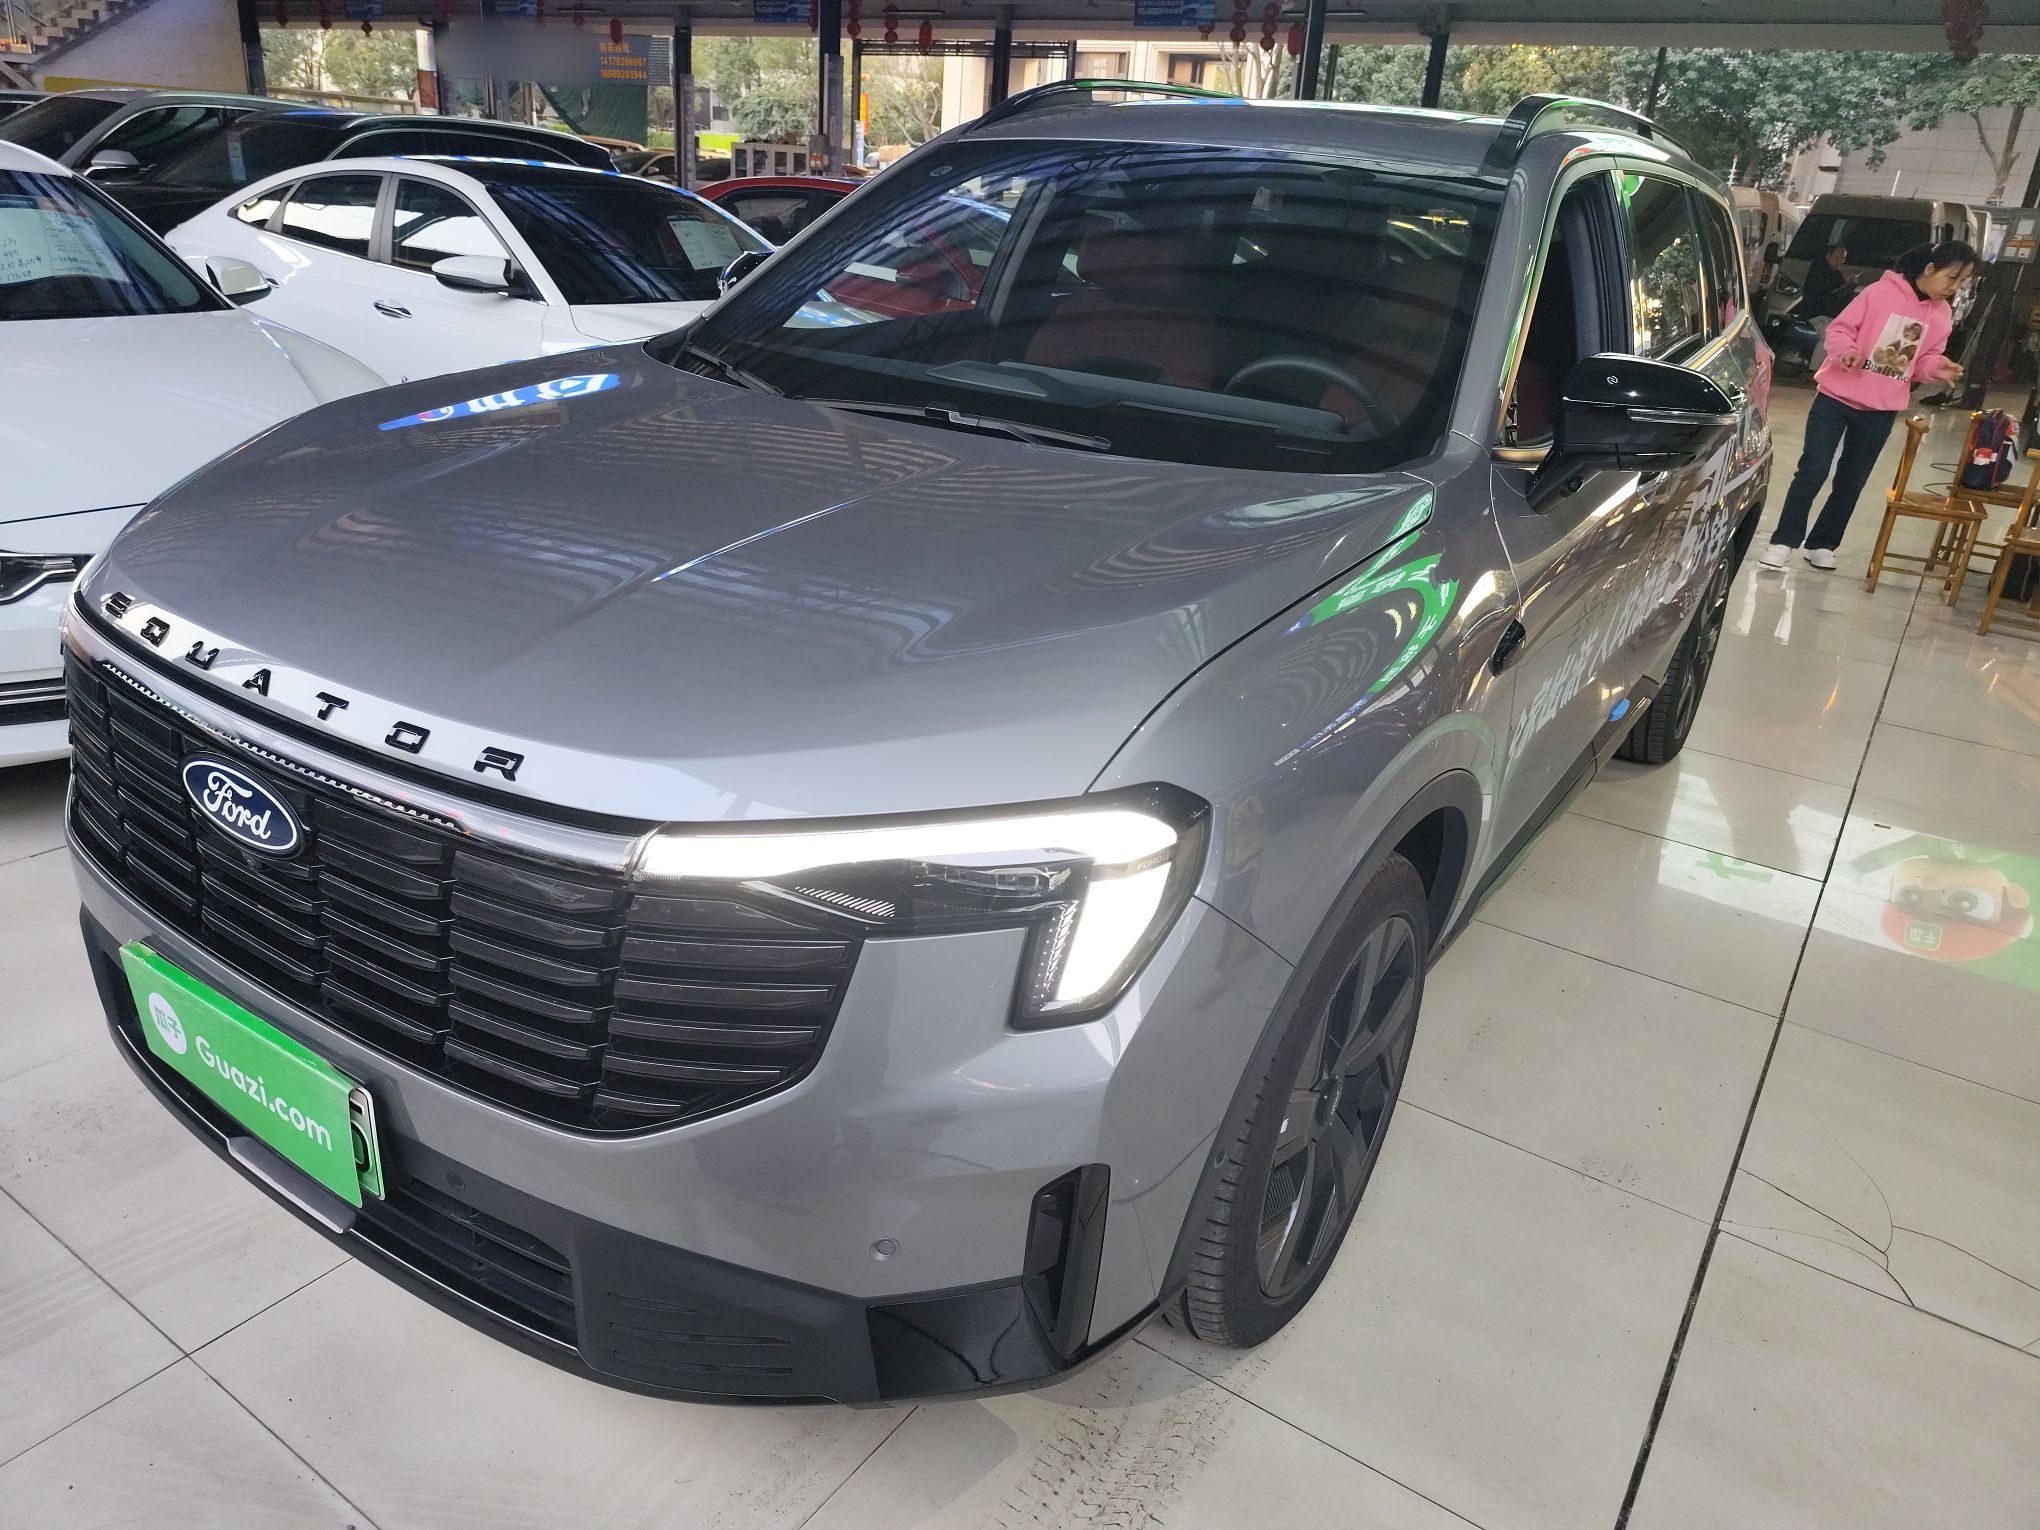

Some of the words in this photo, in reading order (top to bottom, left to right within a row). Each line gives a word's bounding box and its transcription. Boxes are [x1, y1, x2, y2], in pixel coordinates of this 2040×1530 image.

[104, 591, 525, 782] EQUATOR
[203, 771, 272, 840] Ford
[154, 1006, 182, 1040] 瓜子
[195, 1035, 333, 1152] Guazi.com
